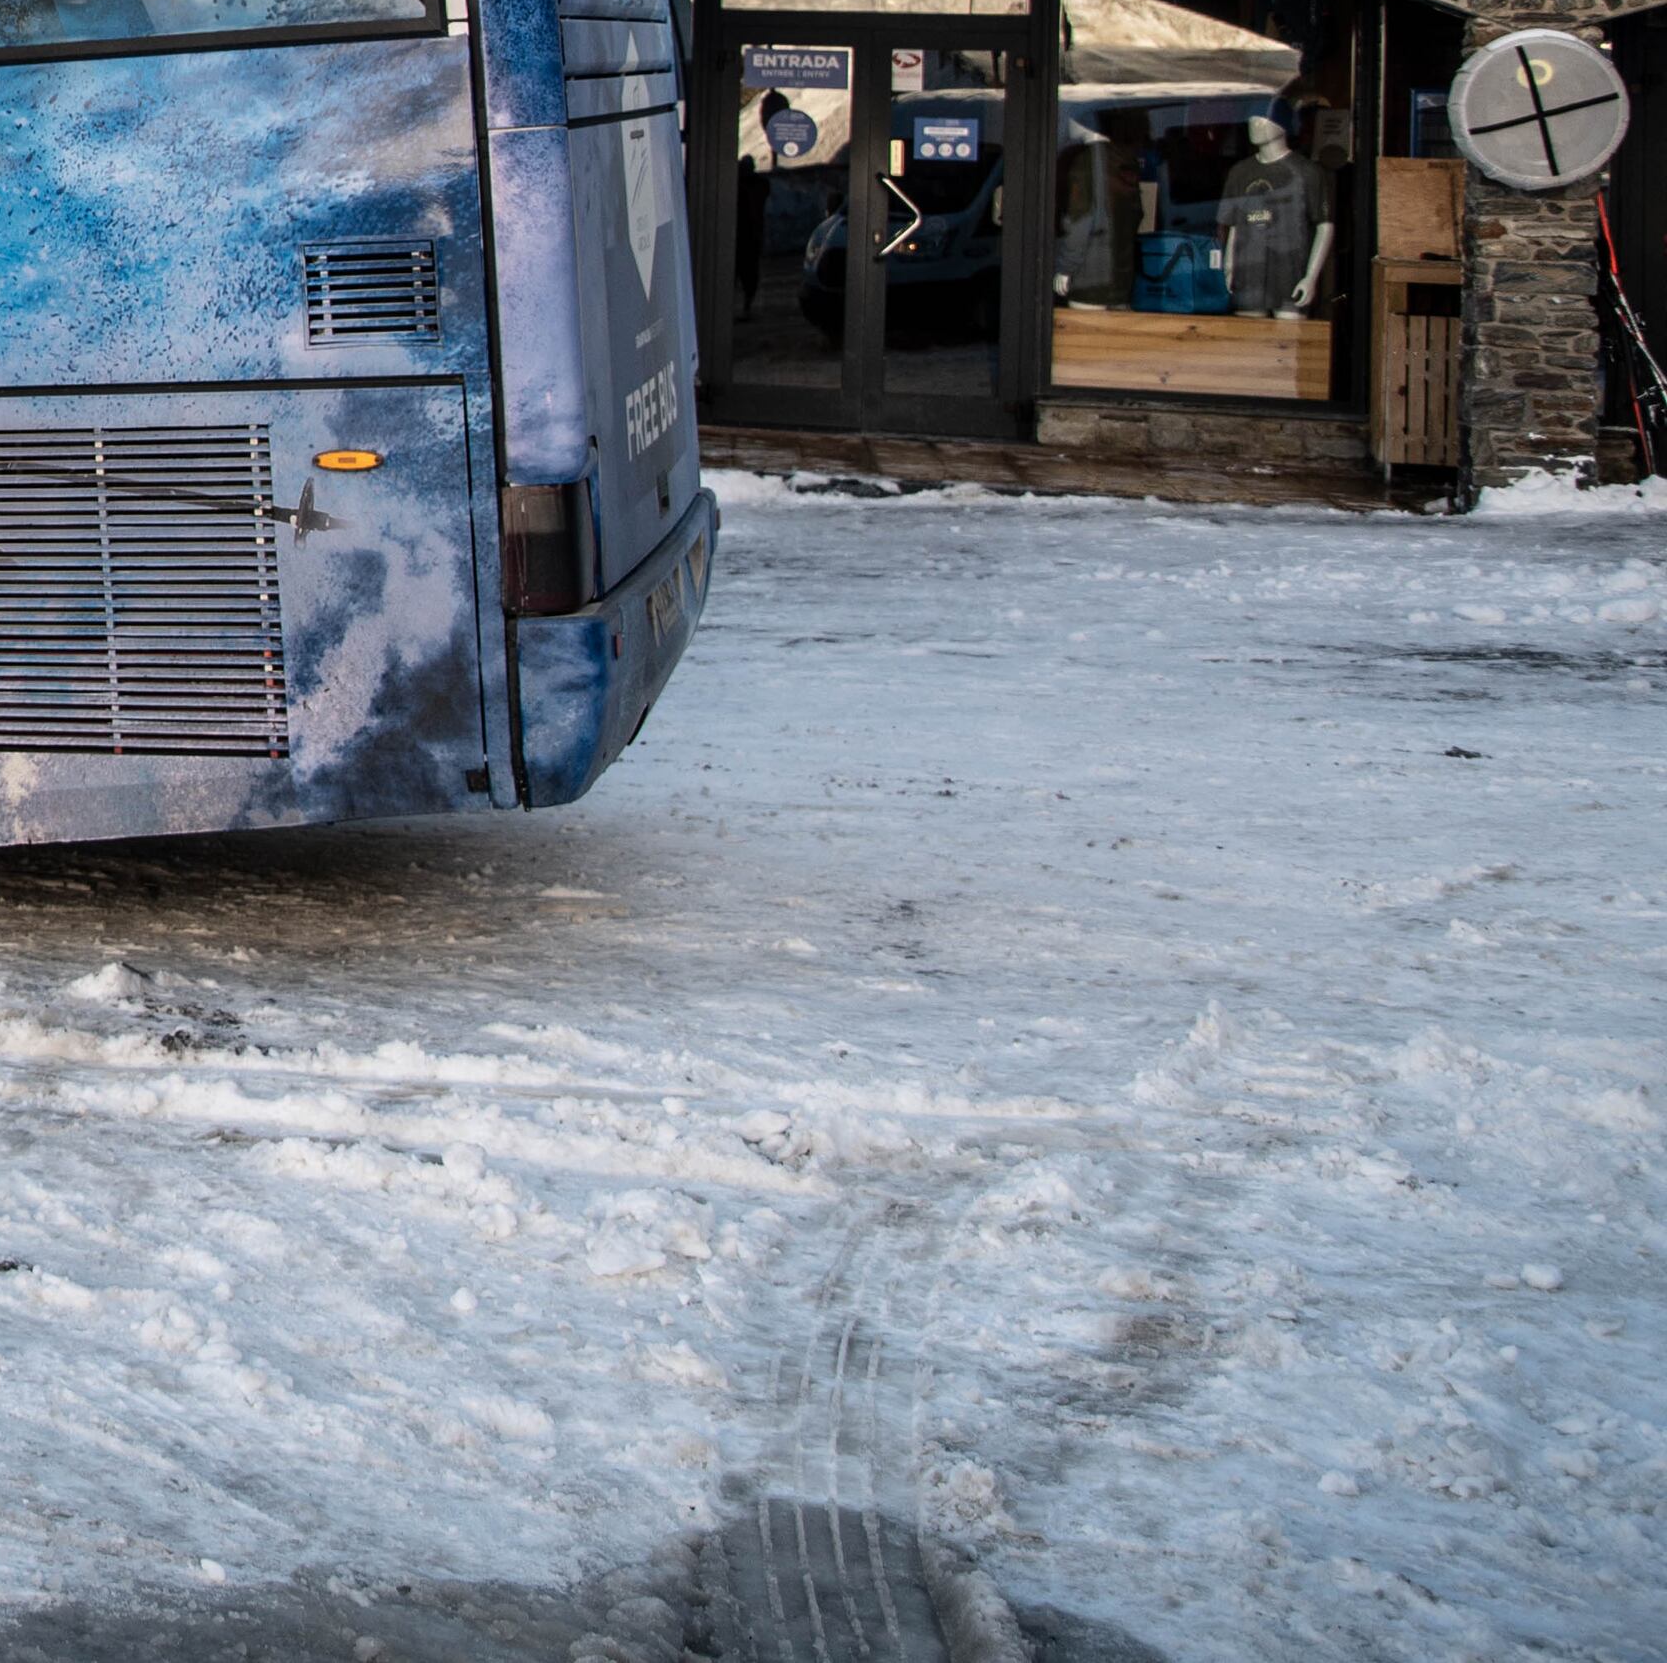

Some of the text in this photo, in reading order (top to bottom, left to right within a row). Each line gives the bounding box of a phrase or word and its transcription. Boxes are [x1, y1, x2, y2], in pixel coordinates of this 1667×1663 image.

[752, 53, 840, 69] ENTRADA
[624, 360, 678, 463] FREE BUS
